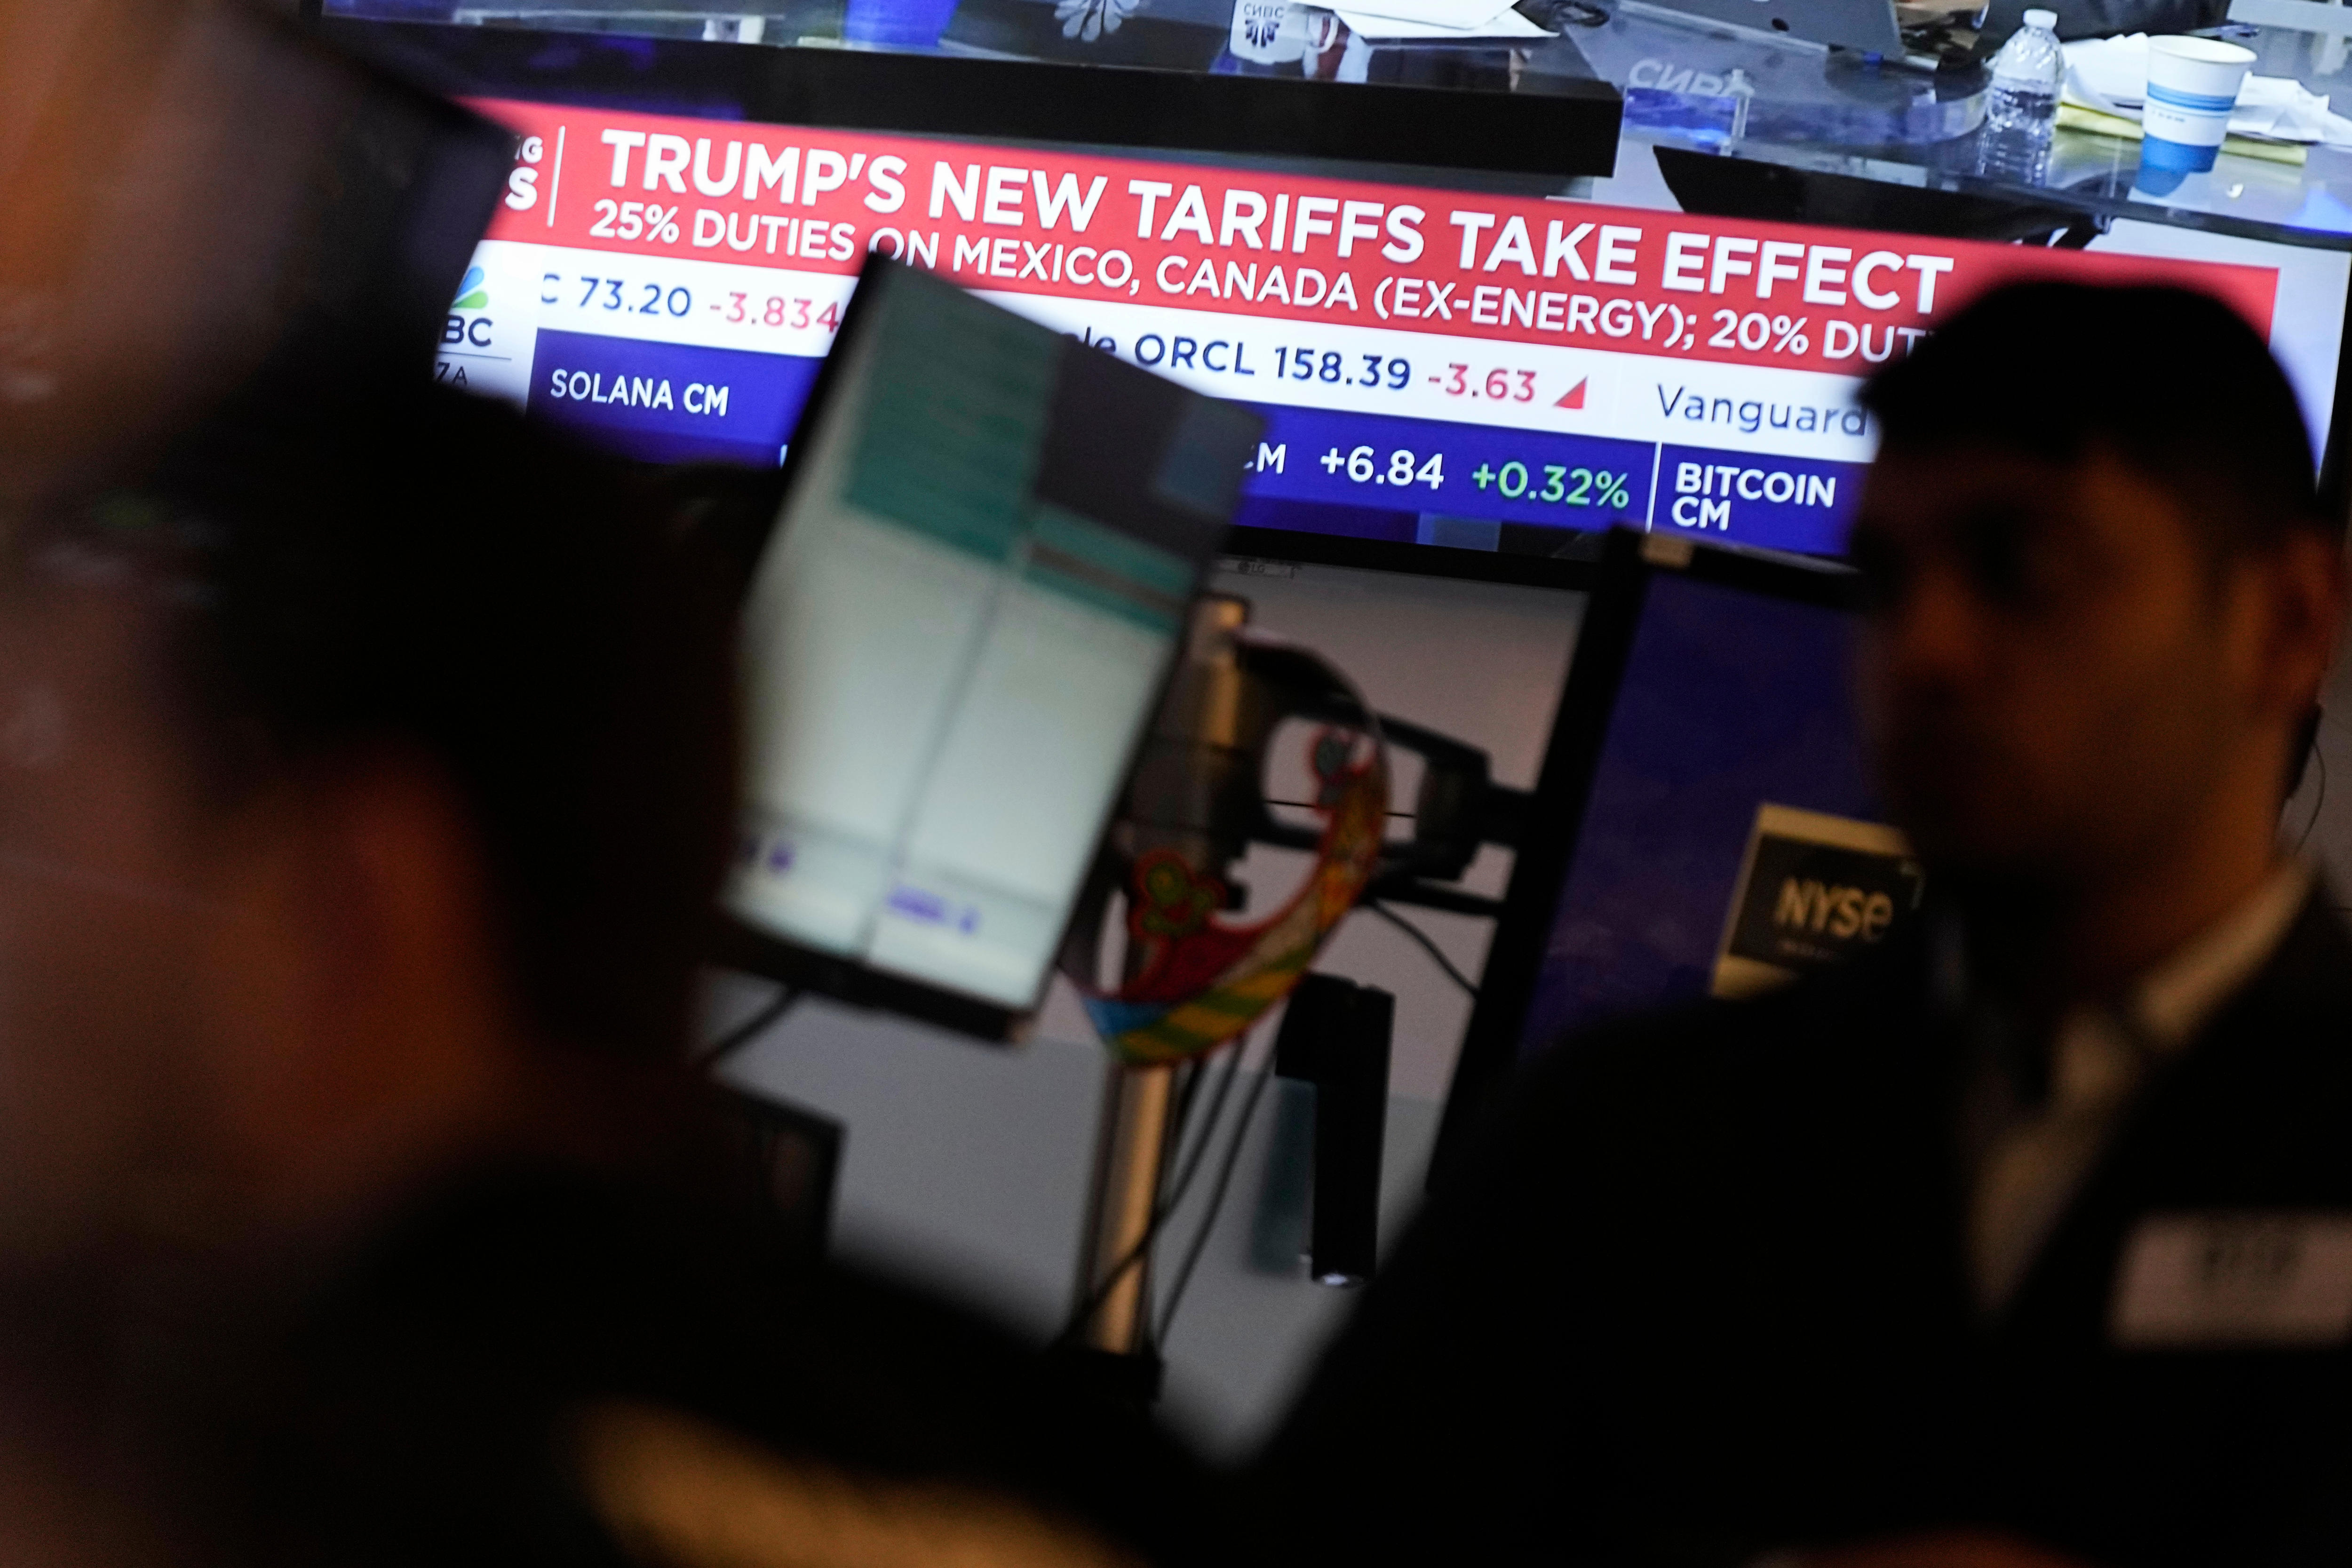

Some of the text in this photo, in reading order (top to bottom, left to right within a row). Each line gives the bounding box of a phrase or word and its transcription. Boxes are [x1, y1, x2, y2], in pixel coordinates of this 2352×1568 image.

[601, 128, 1954, 314] TRUMP'S NEW TARIFFS TAKE EFFECT
[580, 277, 691, 317] 73.20
[709, 292, 839, 333] -3.834
[589, 199, 1933, 362] 25% DUTIES ON MEXICO, CANADA (EX-ENERGY); 20% DUT
[550, 368, 729, 417] SOLANA CM
[1135, 334, 1255, 375] ORCL
[1275, 346, 1411, 390] 158.39
[1429, 363, 1536, 402] -3.63
[1658, 384, 1867, 437] Vanguard
[1320, 446, 1445, 490] +6.84
[1472, 461, 1629, 509] +0.32%
[1675, 462, 1836, 508] BITCOIN
[1671, 495, 1731, 531] CM
